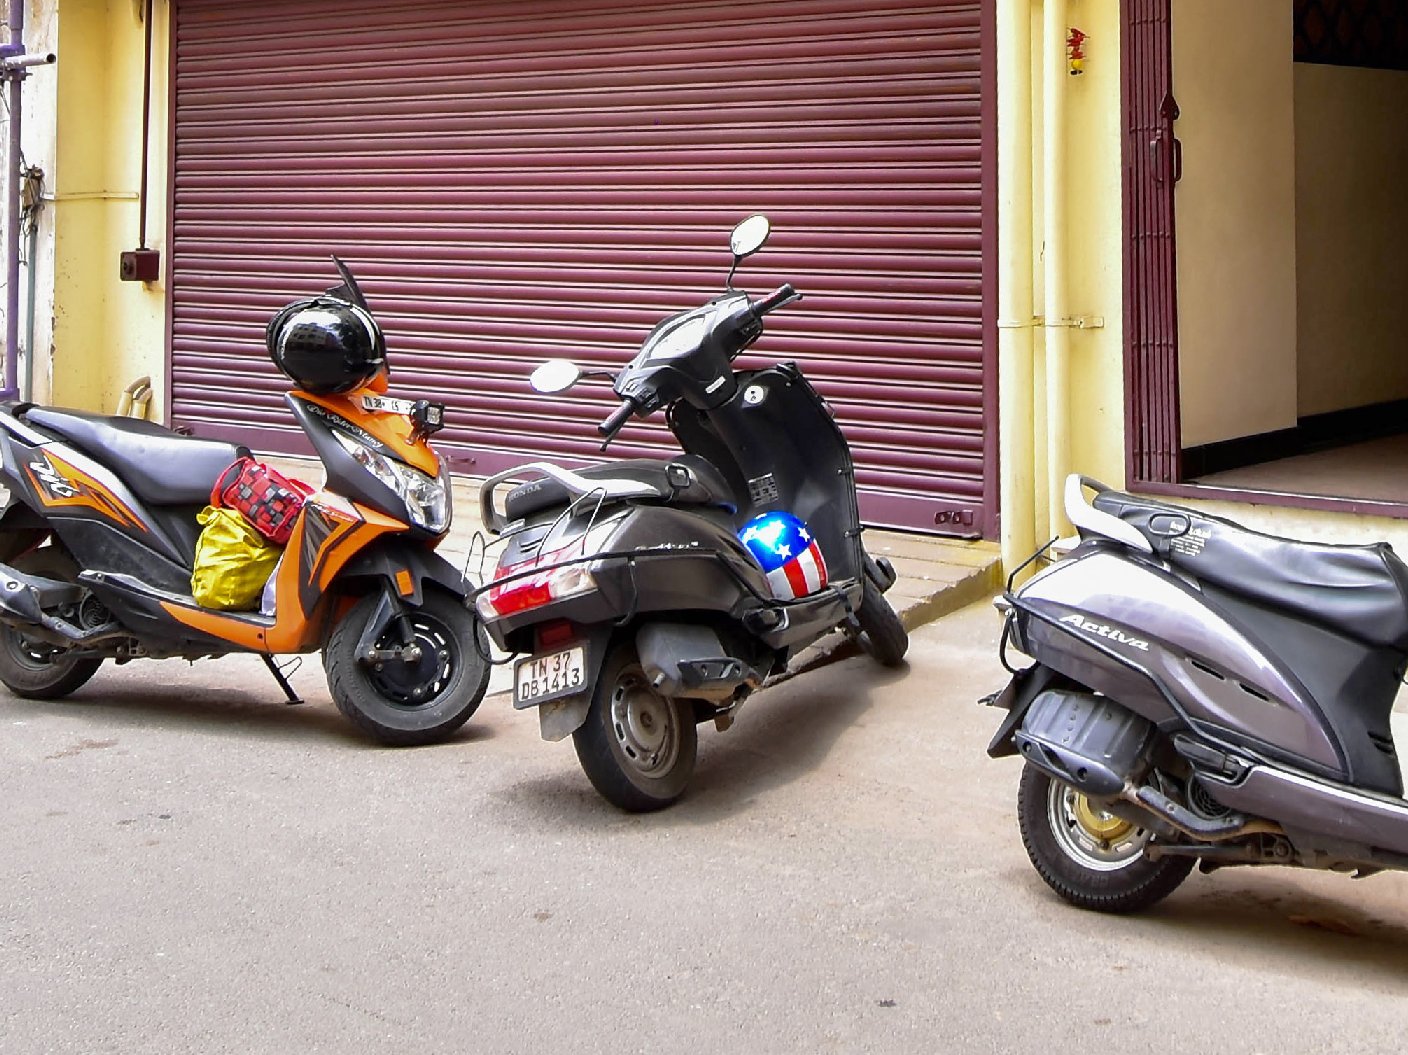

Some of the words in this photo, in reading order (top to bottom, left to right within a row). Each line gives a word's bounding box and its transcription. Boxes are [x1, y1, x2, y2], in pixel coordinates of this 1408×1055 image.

[508, 484, 542, 502] HONDA
[1059, 614, 1149, 652] Activa
[530, 658, 548, 679] TN
[552, 651, 571, 672] 37
